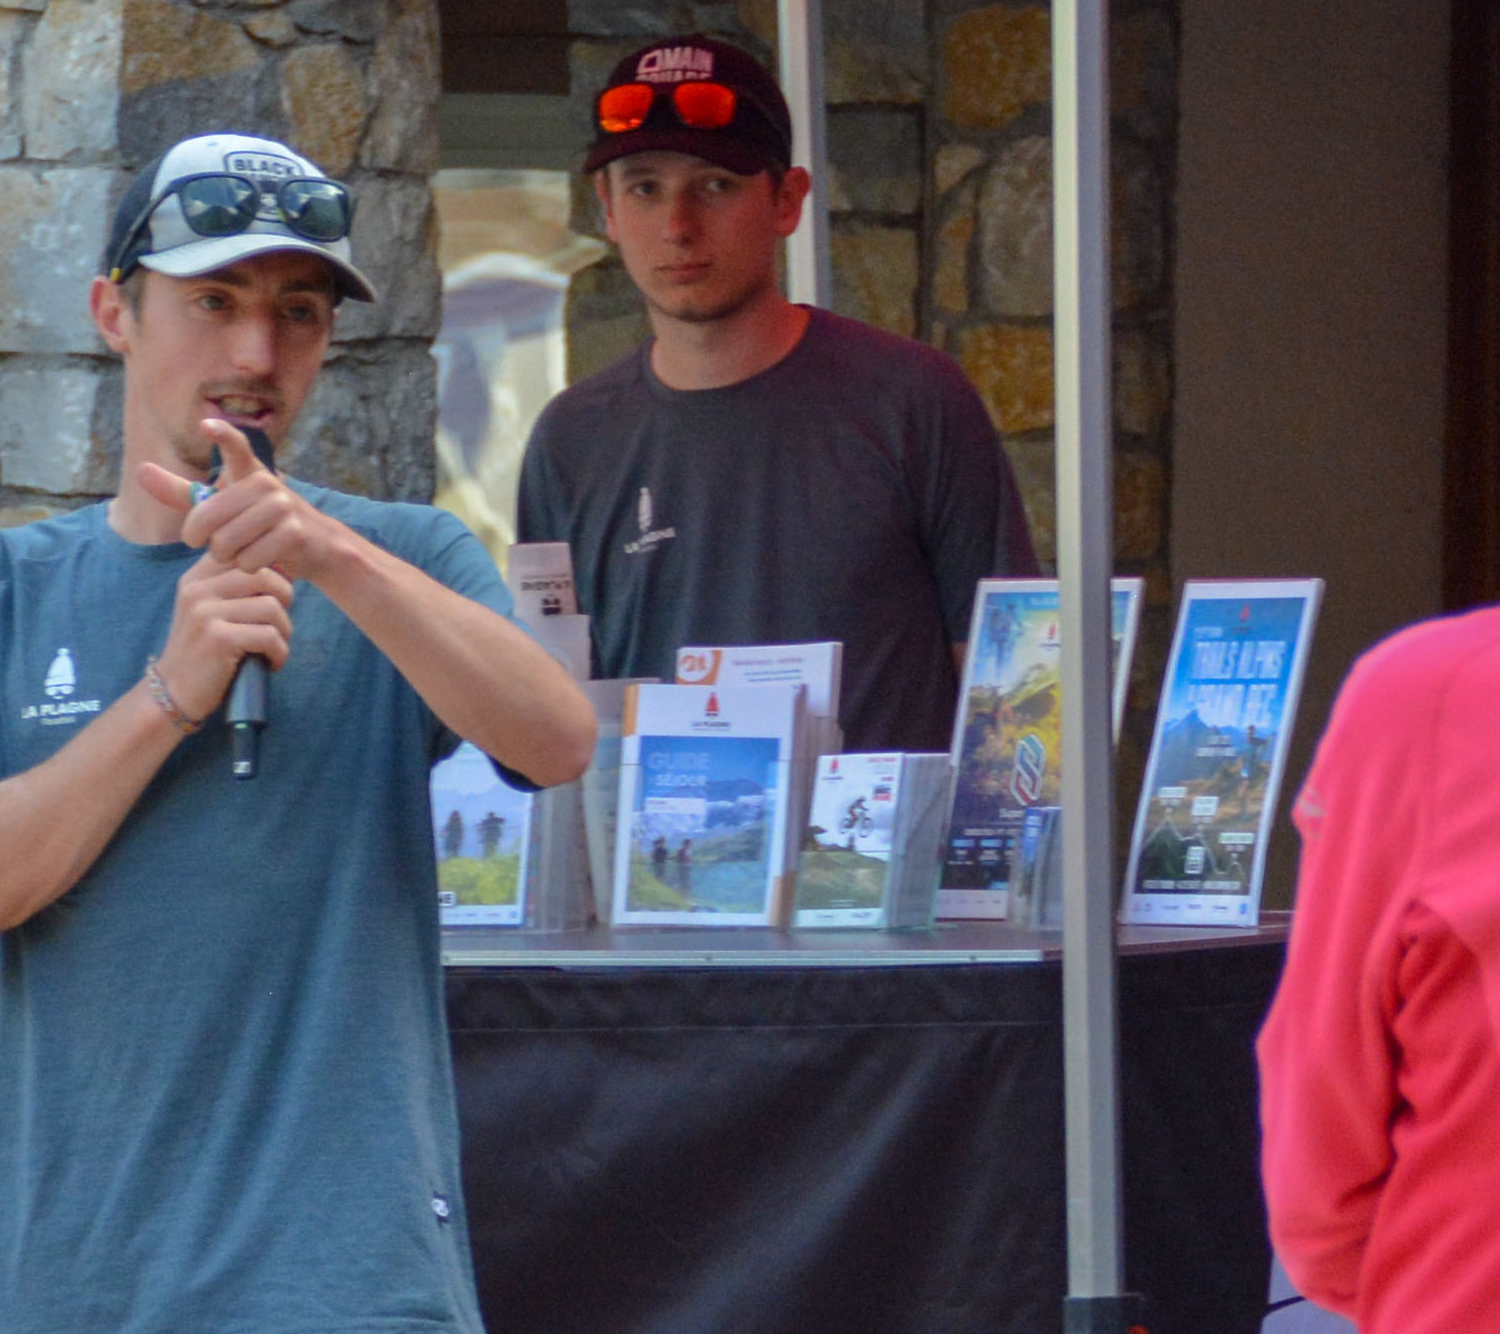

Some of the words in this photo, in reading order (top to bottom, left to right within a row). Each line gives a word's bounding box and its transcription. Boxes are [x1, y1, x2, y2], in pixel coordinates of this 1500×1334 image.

[234, 158, 295, 175] BLACK
[21, 706, 38, 719] LA
[40, 700, 101, 716] PLAGNE
[650, 753, 710, 770] GUIDE
